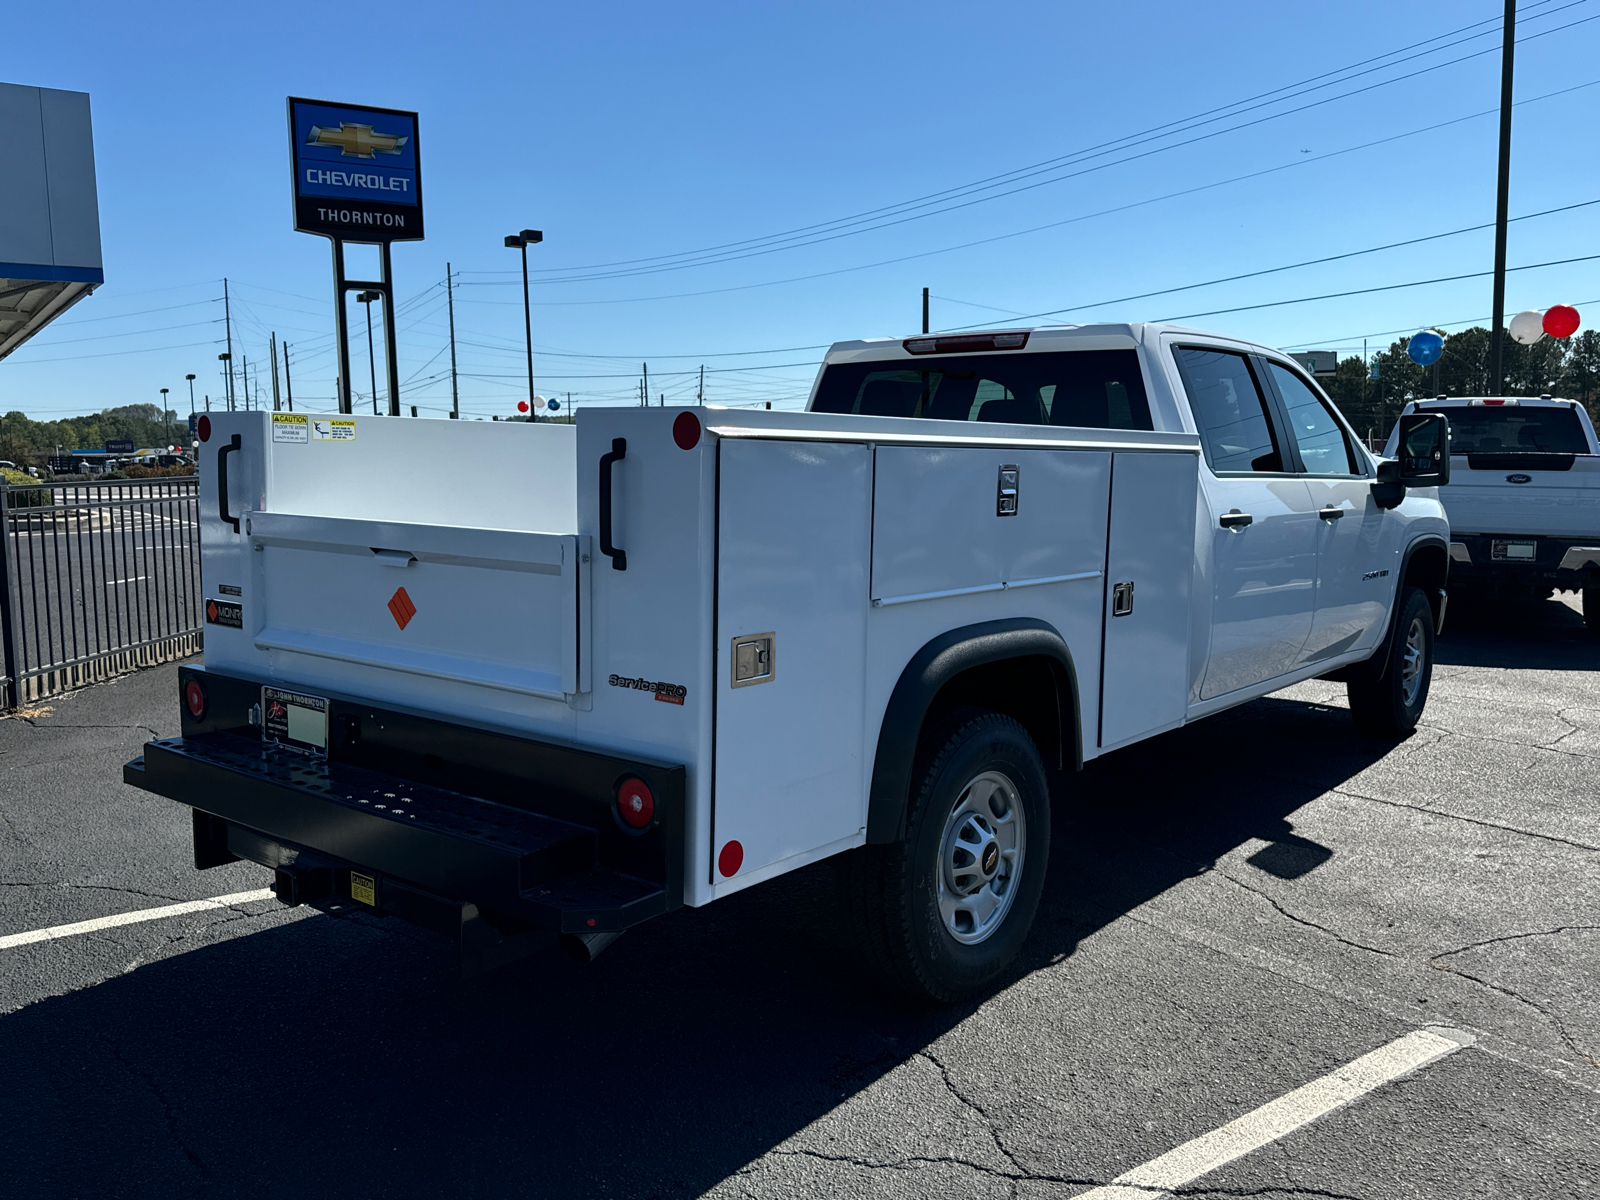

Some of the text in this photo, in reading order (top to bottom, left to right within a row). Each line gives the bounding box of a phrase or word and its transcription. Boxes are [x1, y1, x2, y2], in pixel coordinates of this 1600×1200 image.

[306, 168, 410, 192] CHEVROLET
[317, 207, 405, 228] THORNTON
[279, 415, 307, 424] CAUTION
[608, 673, 687, 698] ServicePRO
[277, 691, 324, 708] JOHN THORNTON
